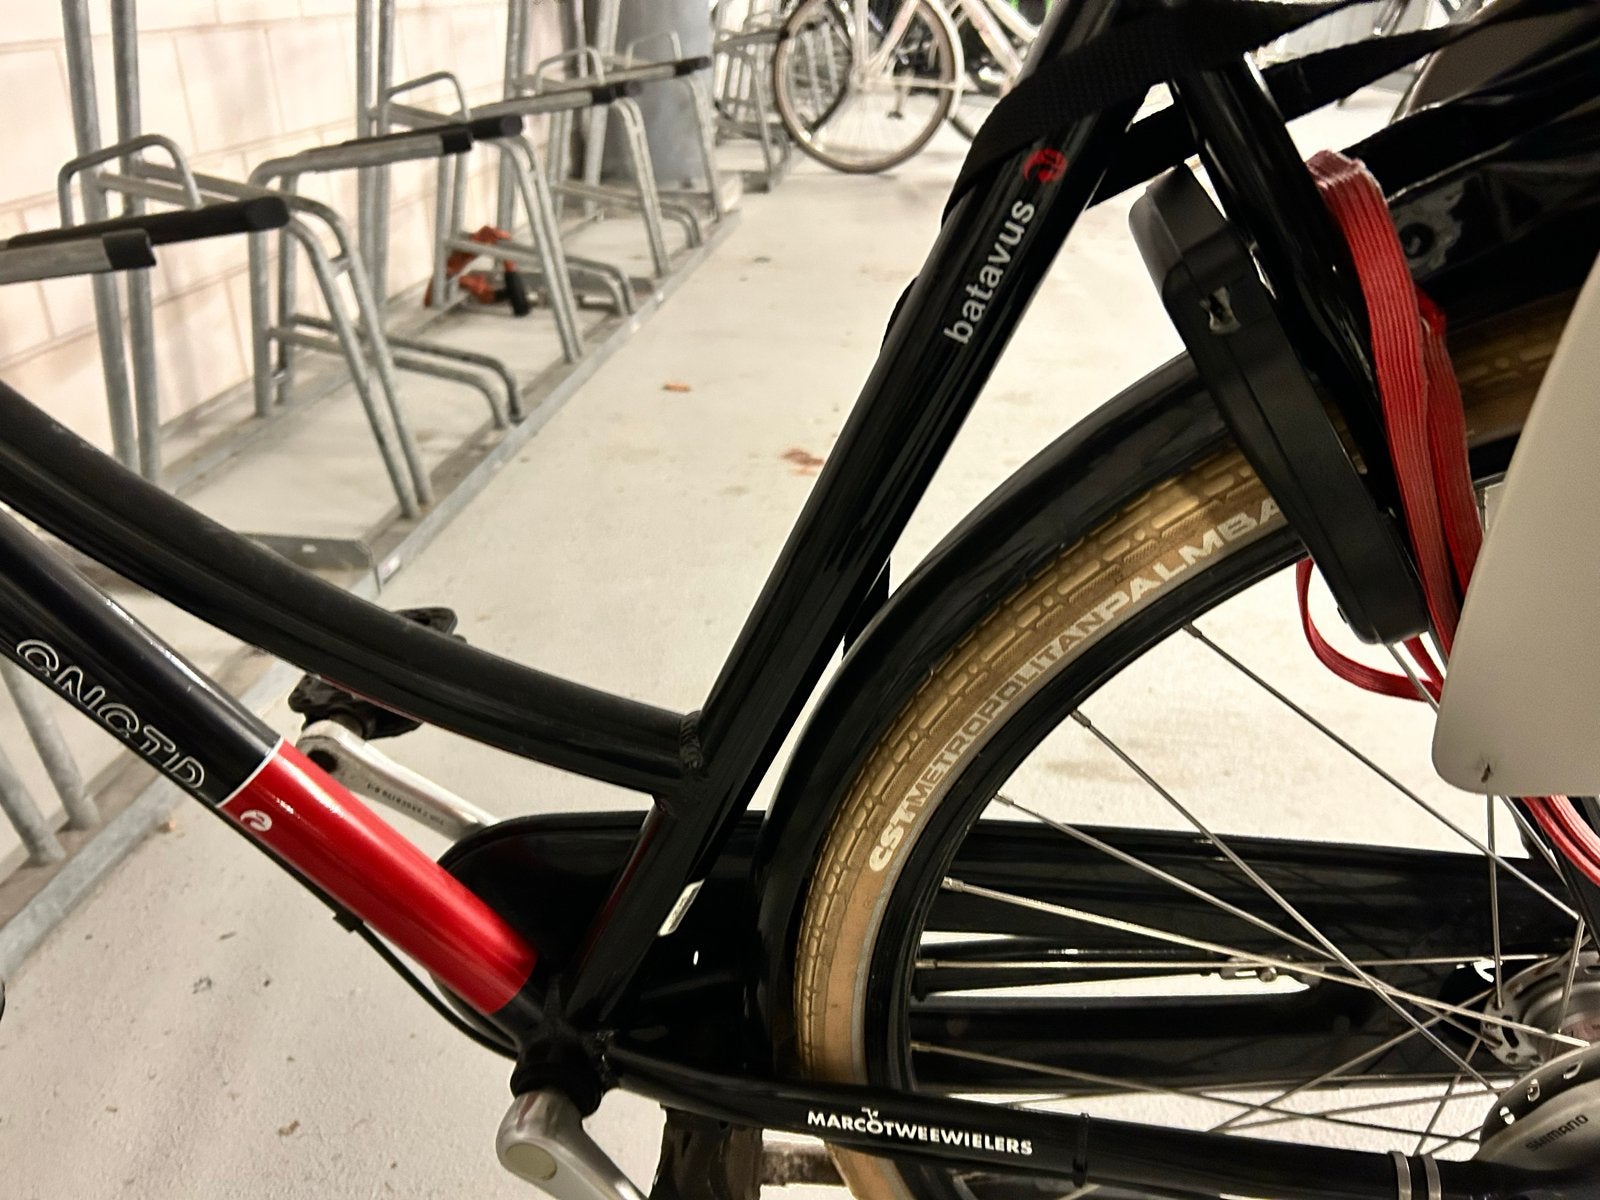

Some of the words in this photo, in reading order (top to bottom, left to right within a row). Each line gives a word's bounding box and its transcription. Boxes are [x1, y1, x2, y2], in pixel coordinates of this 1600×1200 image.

[944, 200, 1035, 345] batavus
[869, 804, 916, 872] CST
[902, 608, 1104, 807] METROPOLITAN
[1525, 1114, 1589, 1151] SHIMANO
